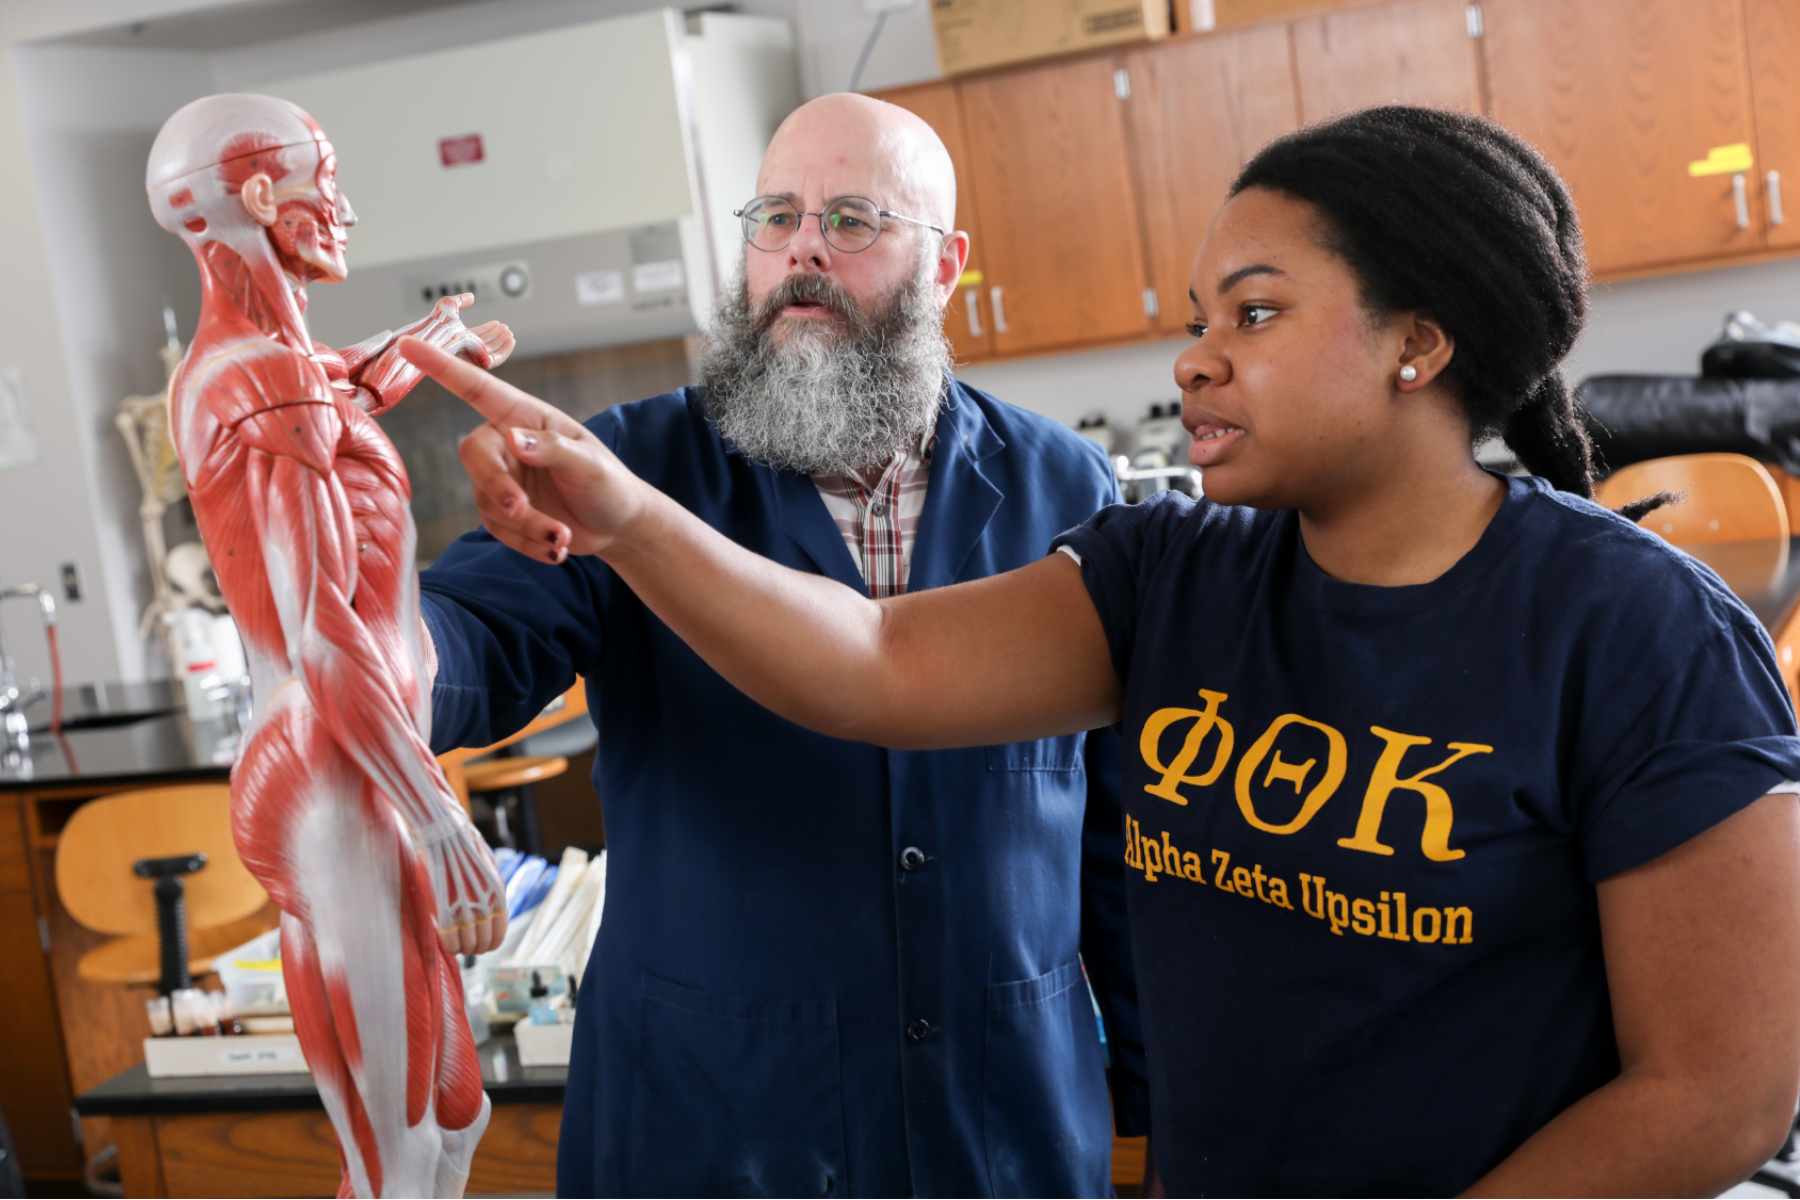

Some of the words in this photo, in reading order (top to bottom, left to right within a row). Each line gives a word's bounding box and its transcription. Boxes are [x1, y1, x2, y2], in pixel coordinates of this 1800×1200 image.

[1124, 813, 1208, 885] Alpha
[1211, 848, 1295, 911] Zeta
[1299, 872, 1474, 945] Upsilon
